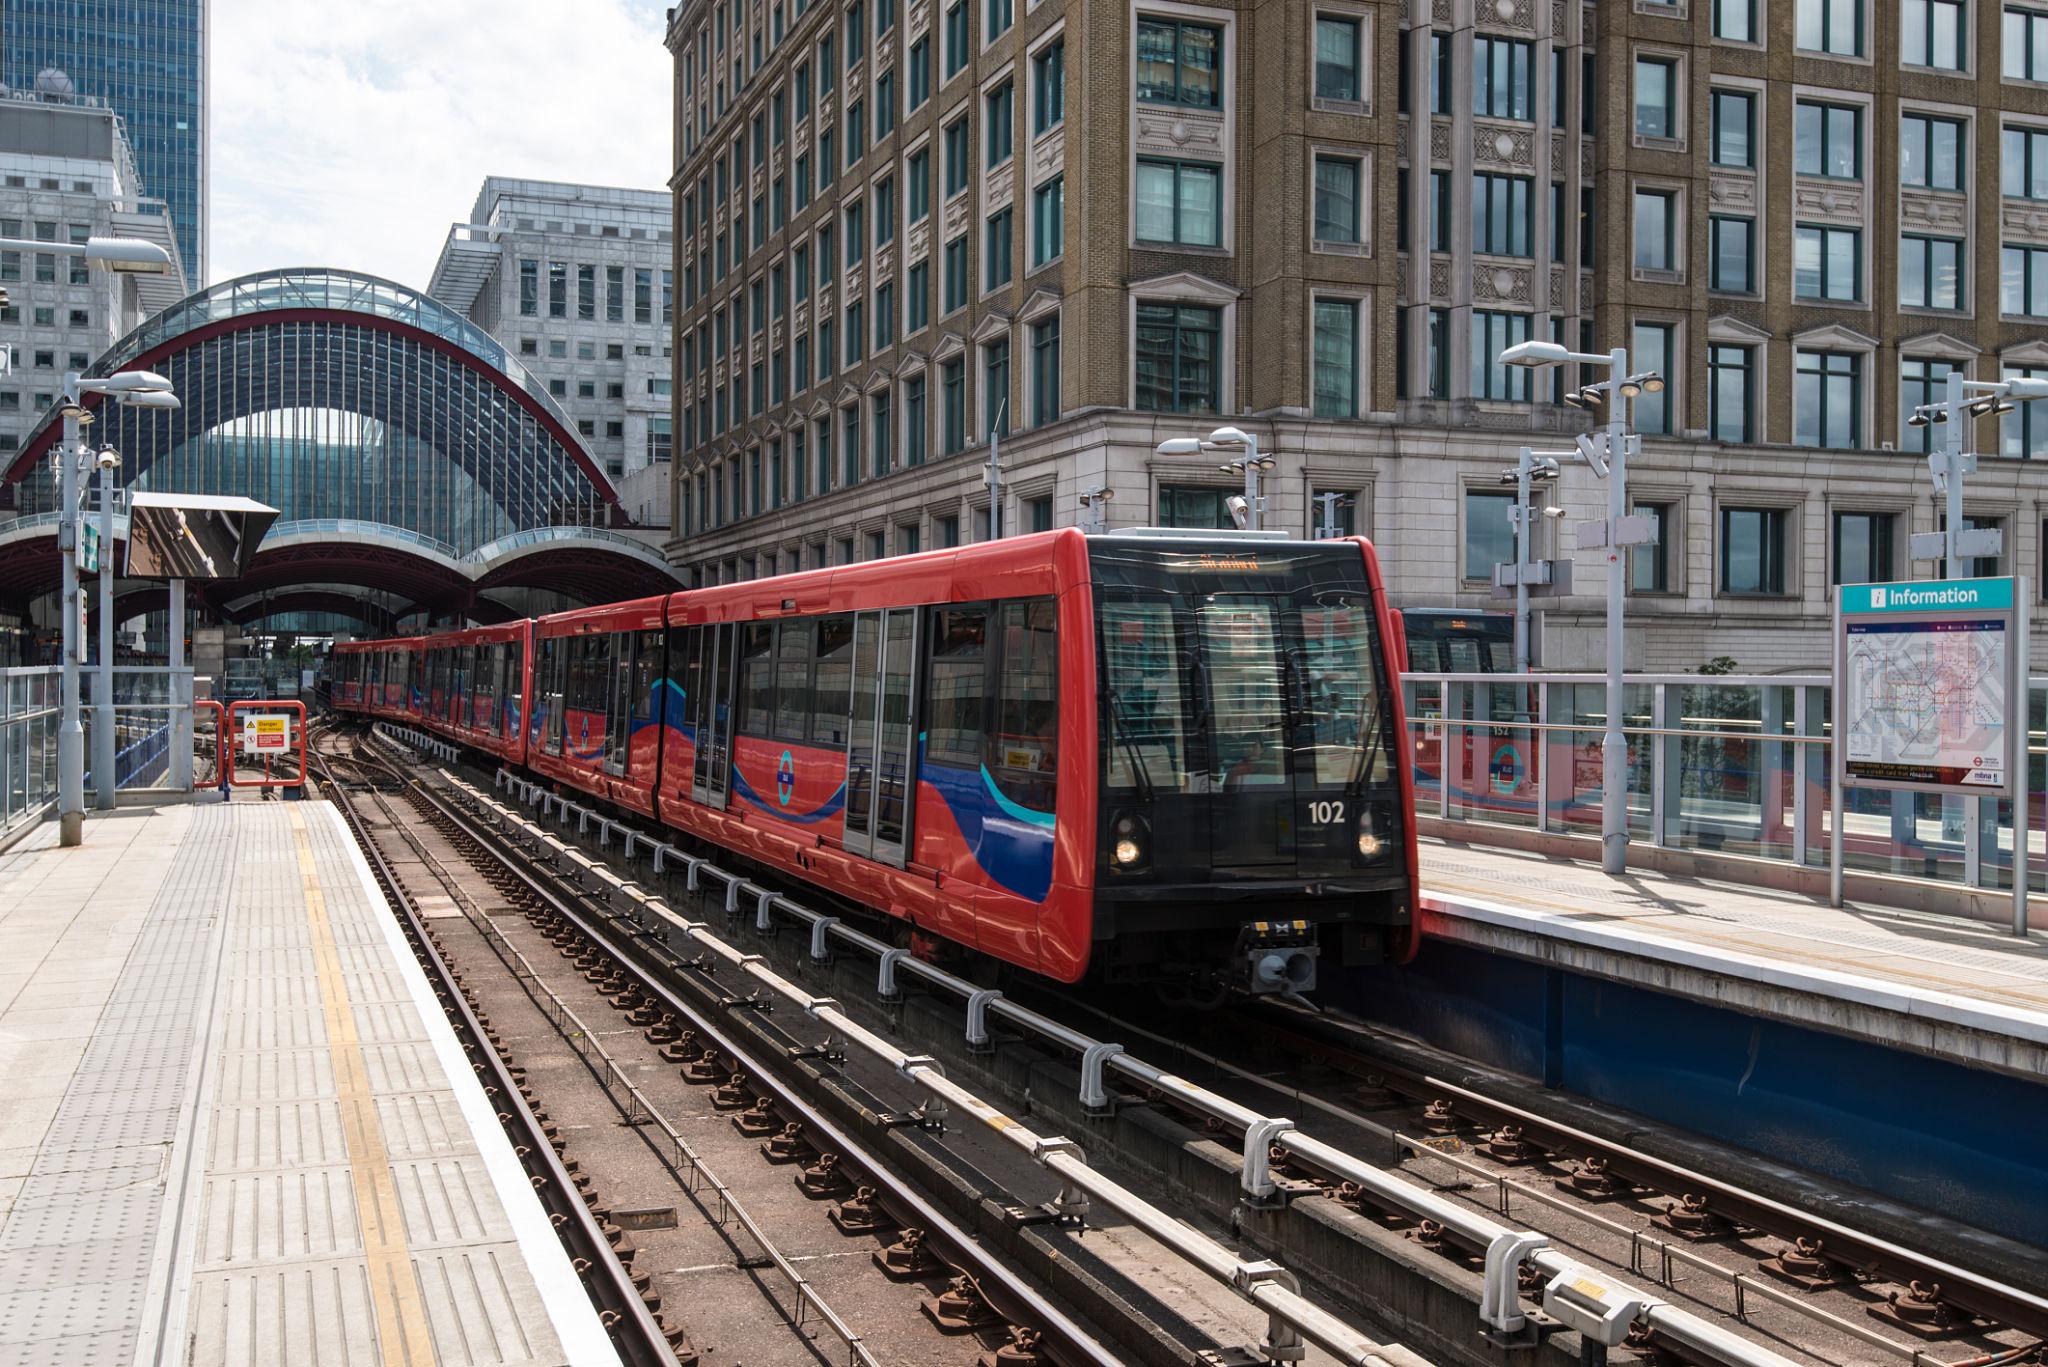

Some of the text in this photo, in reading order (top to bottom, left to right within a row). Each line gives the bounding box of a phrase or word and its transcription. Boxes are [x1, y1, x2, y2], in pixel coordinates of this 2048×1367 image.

[1890, 587, 1978, 605] Information
[1493, 726, 1509, 736] 152
[1308, 801, 1345, 823] 102
